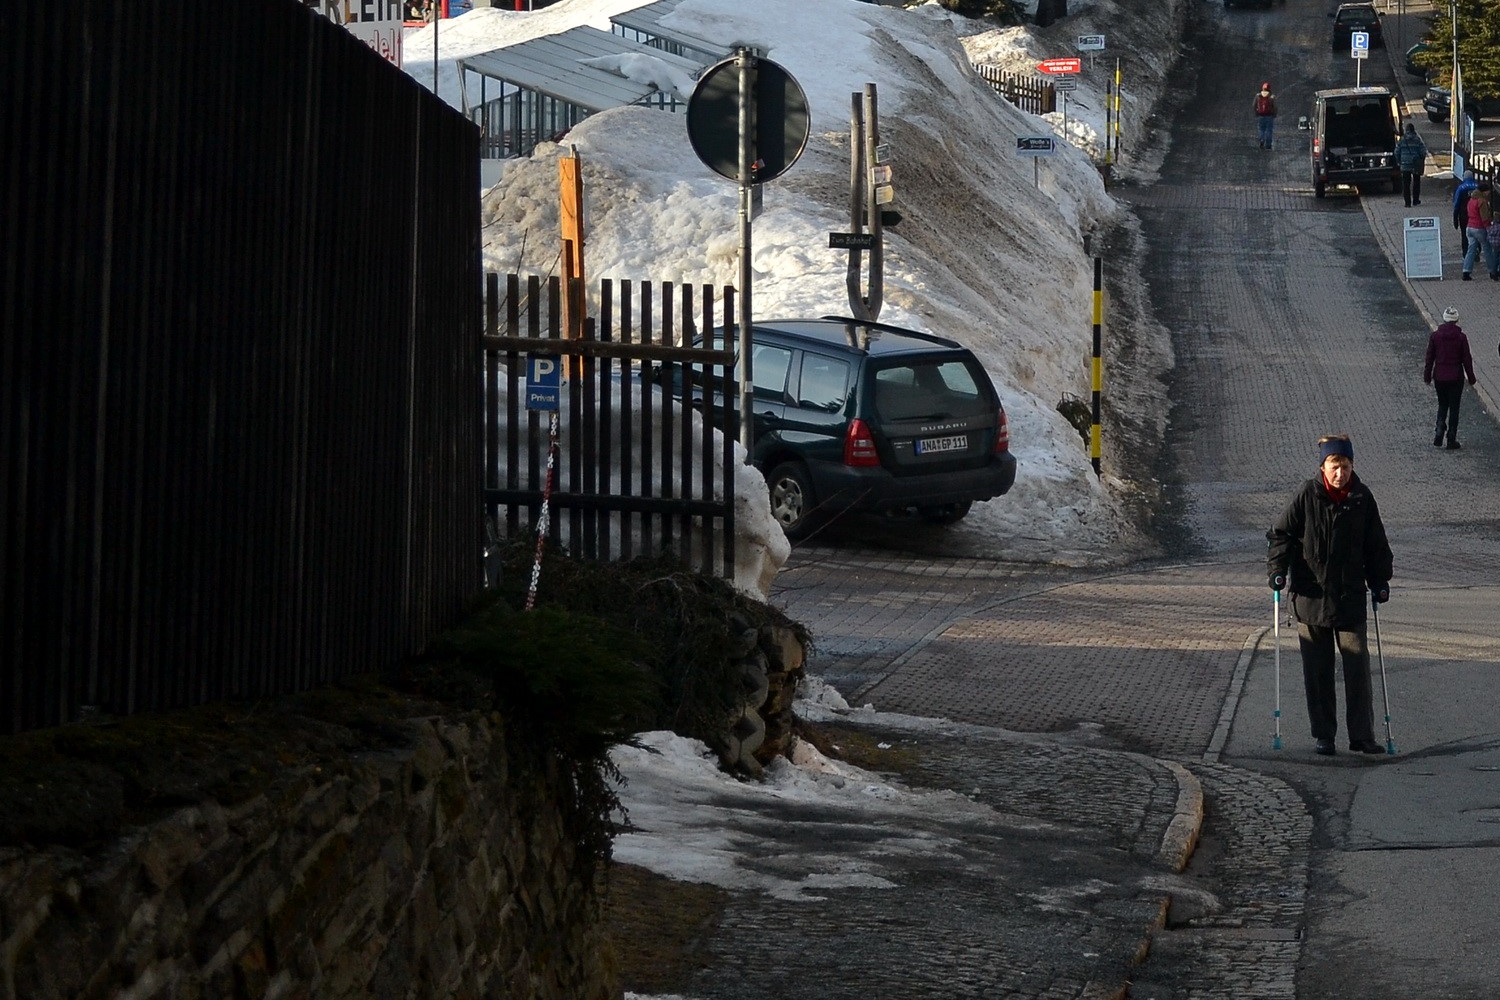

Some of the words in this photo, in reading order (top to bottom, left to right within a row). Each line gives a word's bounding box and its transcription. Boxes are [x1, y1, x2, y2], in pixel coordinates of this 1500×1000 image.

[534, 359, 554, 382] P
[531, 393, 555, 402] Privat
[921, 422, 967, 432] SUBARU
